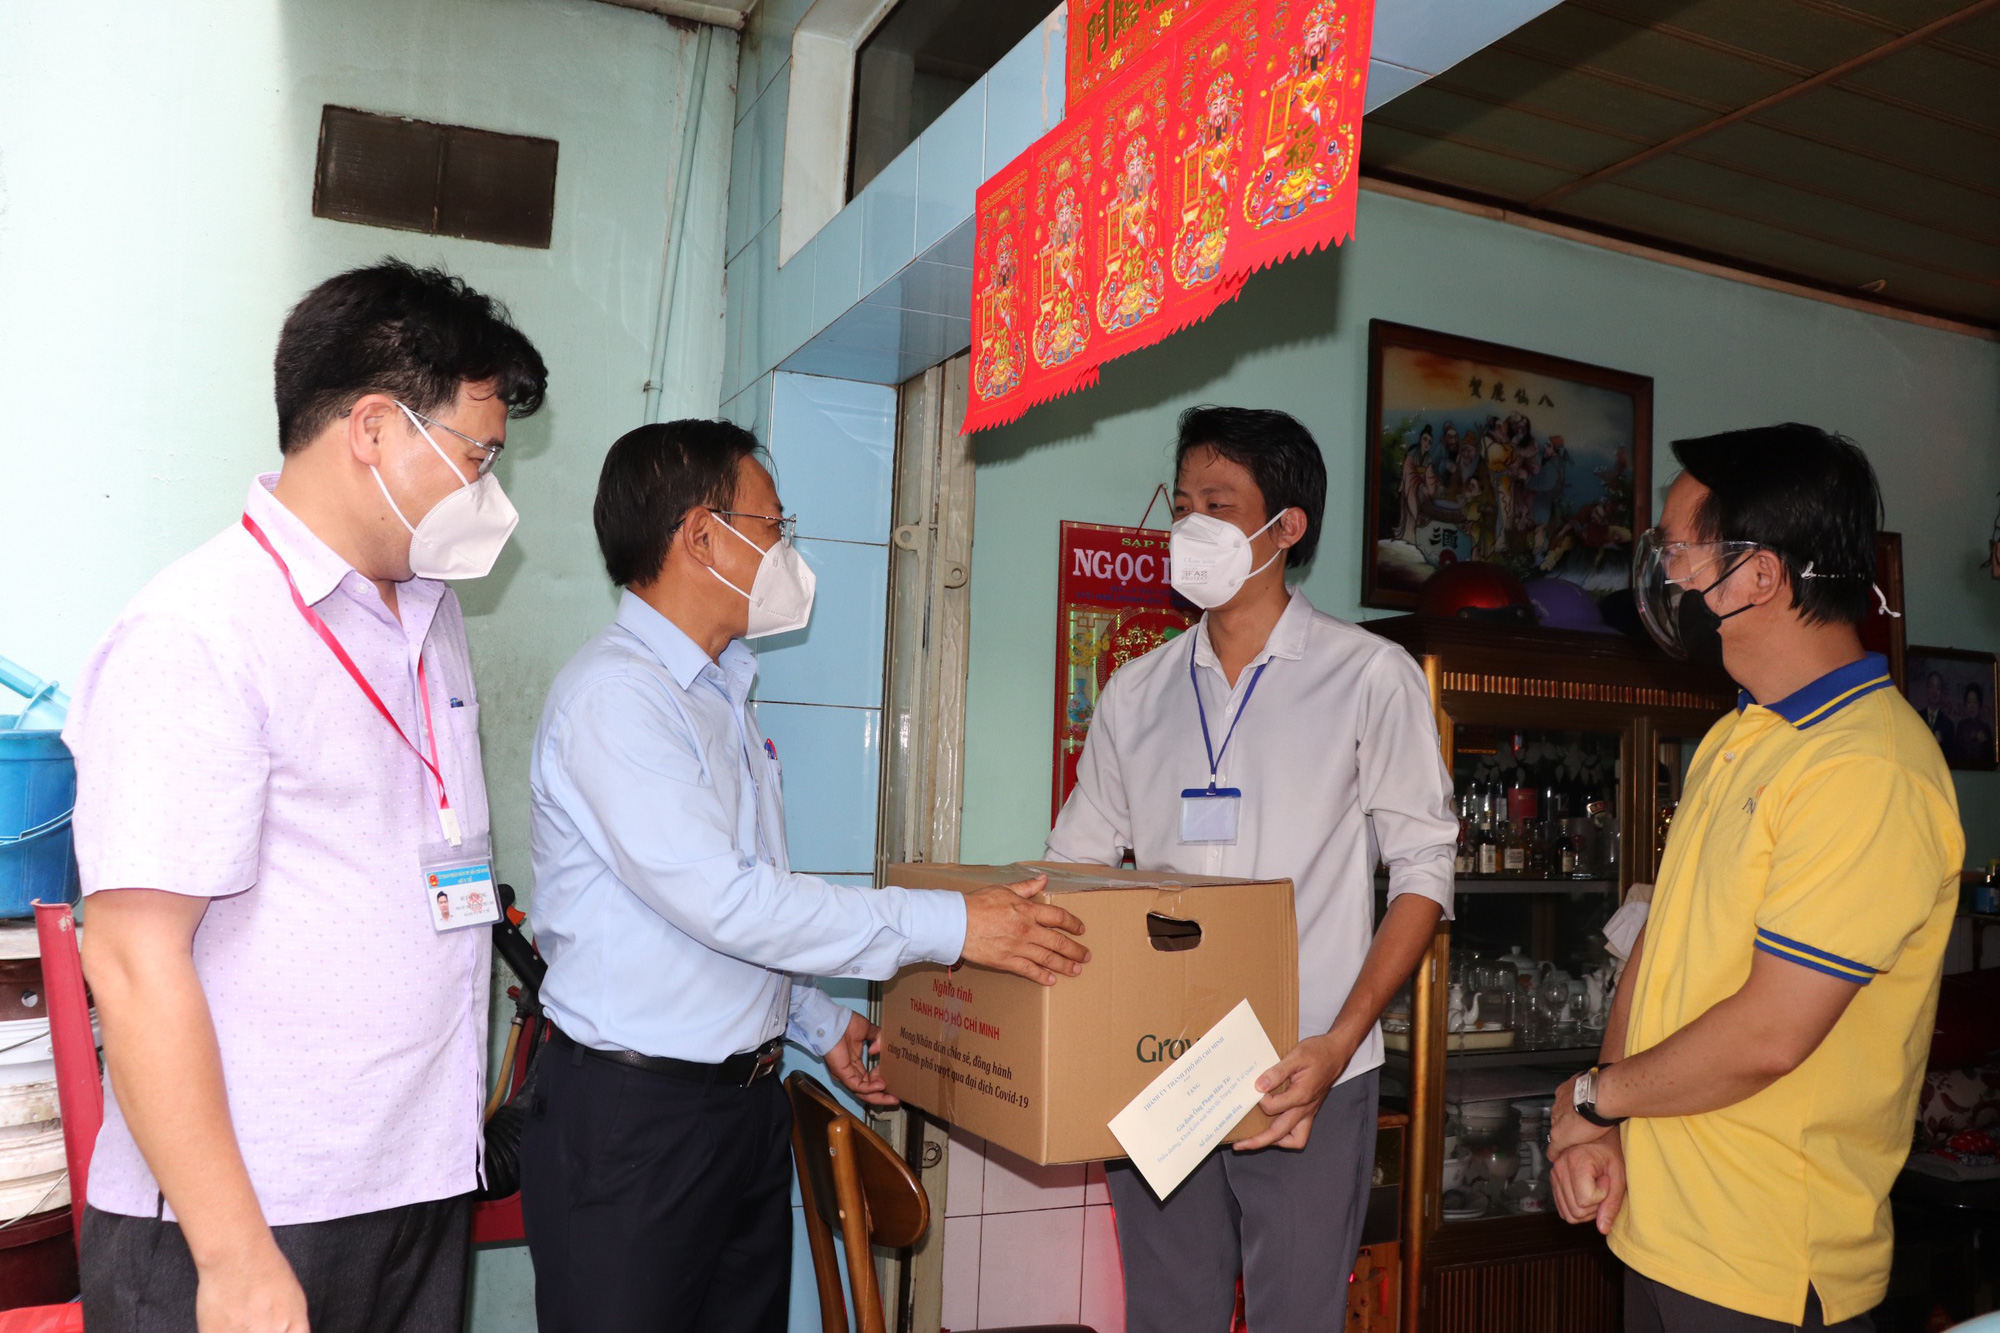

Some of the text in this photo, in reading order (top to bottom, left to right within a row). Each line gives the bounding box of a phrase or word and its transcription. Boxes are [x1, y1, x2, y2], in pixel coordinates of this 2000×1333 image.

[1072, 548, 1155, 586] NGỌC
[910, 998, 932, 1017] THÀNH
[963, 1016, 977, 1033] CHÍ
[979, 1021, 1000, 1040] MINH
[900, 1026, 916, 1046] Mong
[946, 1045, 962, 1061] chia
[992, 1061, 1012, 1080] hành
[950, 1070, 964, 1084] qua
[994, 1085, 1029, 1109] Covid-19
